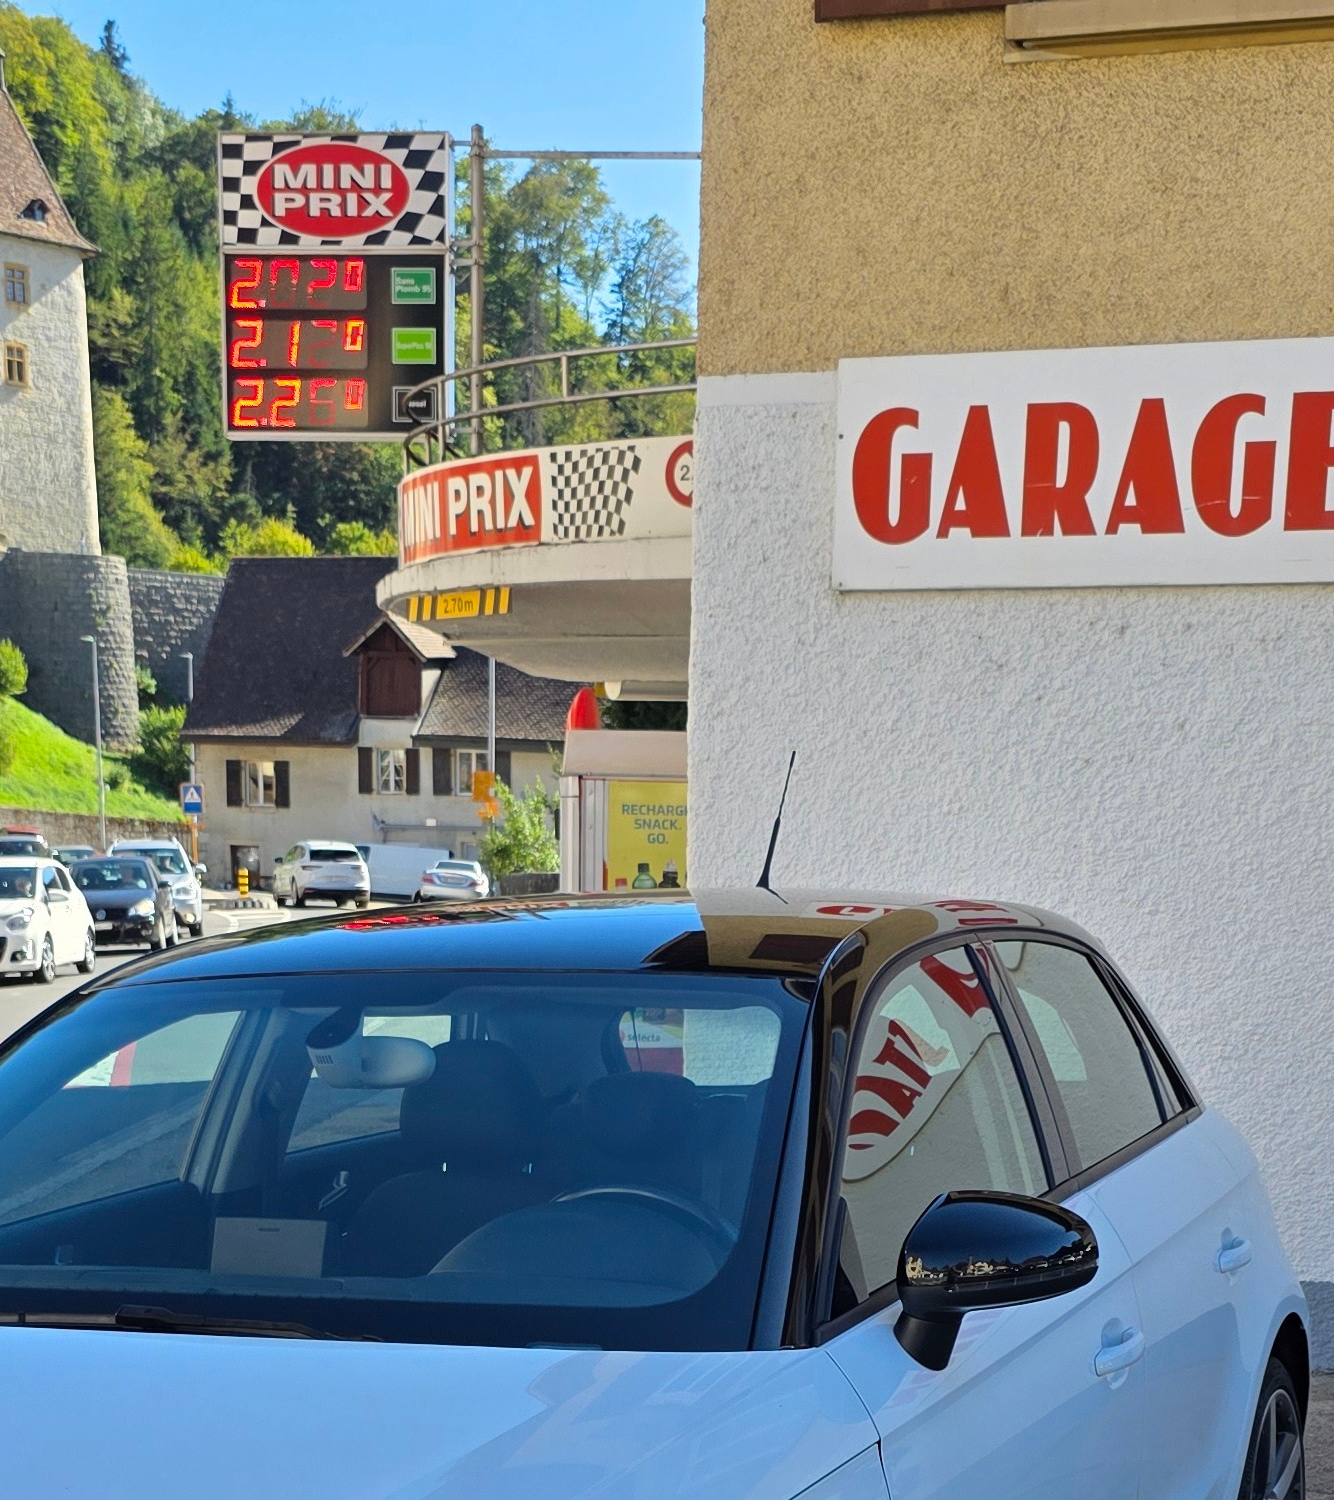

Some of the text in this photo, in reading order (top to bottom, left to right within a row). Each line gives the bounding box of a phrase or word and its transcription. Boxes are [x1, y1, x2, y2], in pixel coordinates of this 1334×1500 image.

[273, 163, 392, 190] MINI
[273, 192, 394, 217] PRIX
[403, 466, 535, 546] MINI PRIX
[622, 804, 688, 816] RECHARG
[634, 818, 682, 830] SNACK.
[647, 833, 669, 845] GO.
